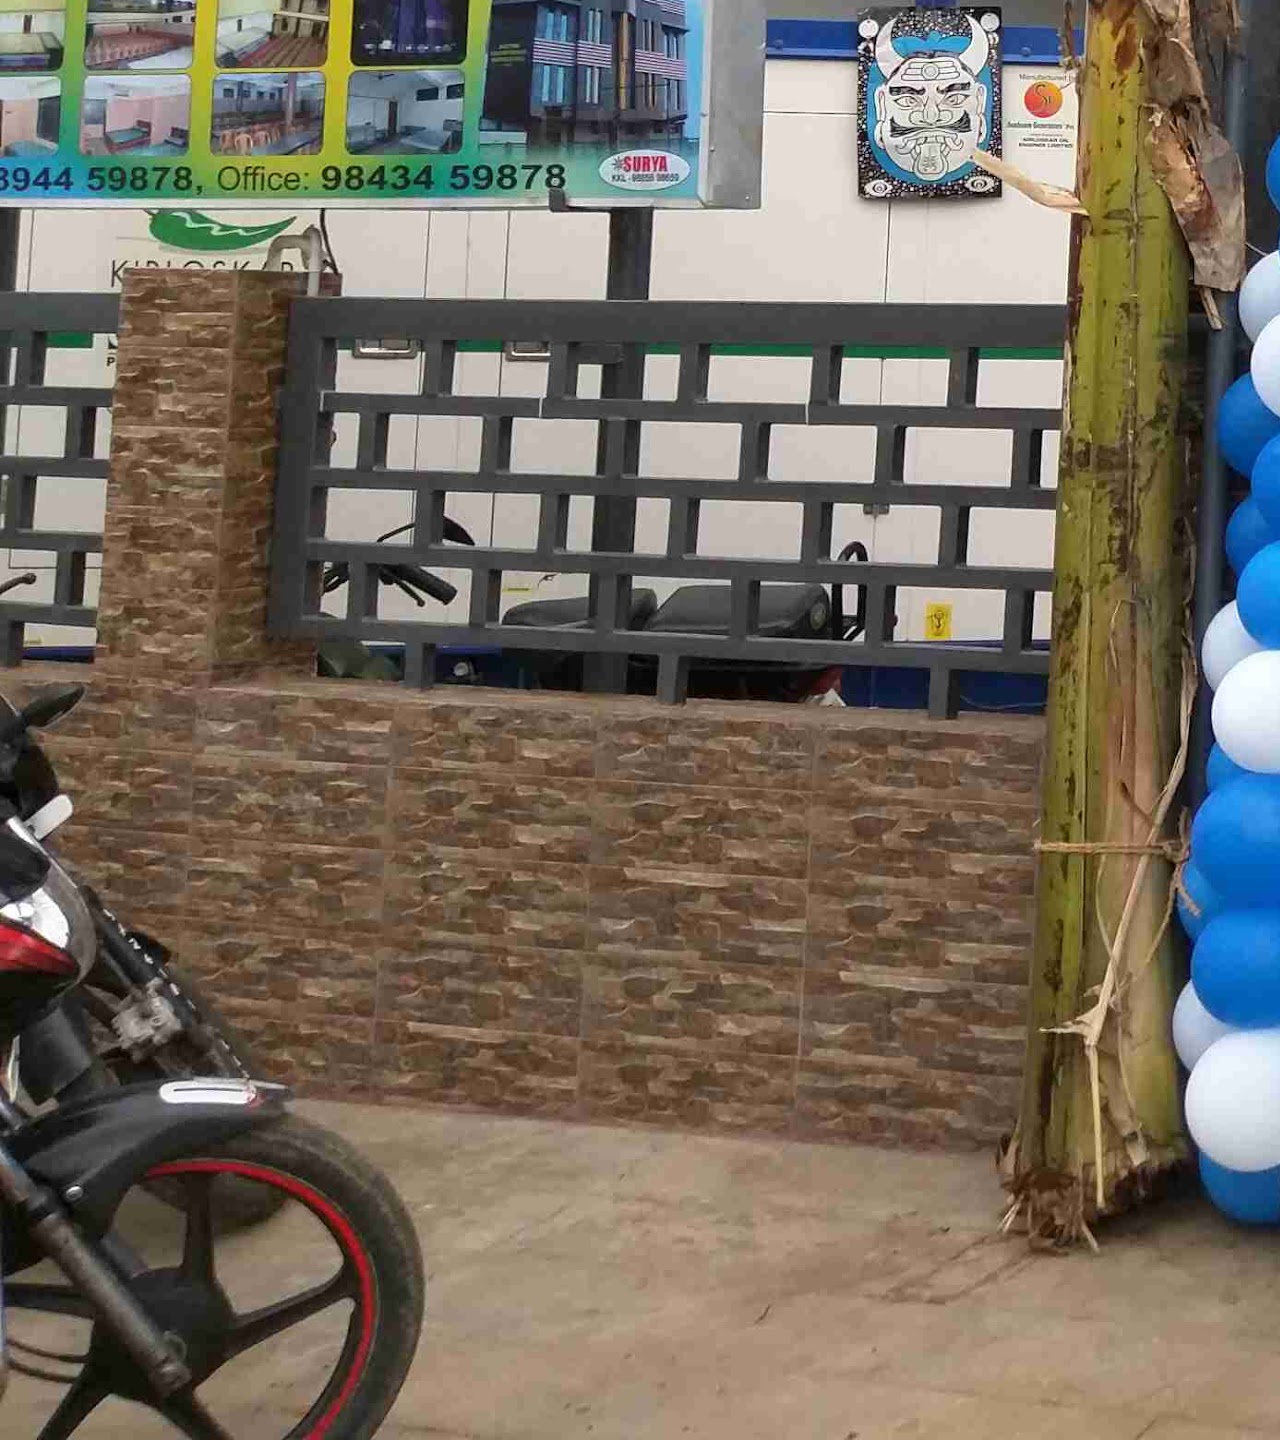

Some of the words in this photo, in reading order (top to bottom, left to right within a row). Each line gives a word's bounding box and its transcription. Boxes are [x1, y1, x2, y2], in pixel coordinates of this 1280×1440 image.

[623, 155, 668, 173] SURYA
[87, 166, 203, 196] 59878,
[217, 164, 310, 191] Office:
[321, 163, 435, 191] 98434
[450, 163, 566, 191] 59878
